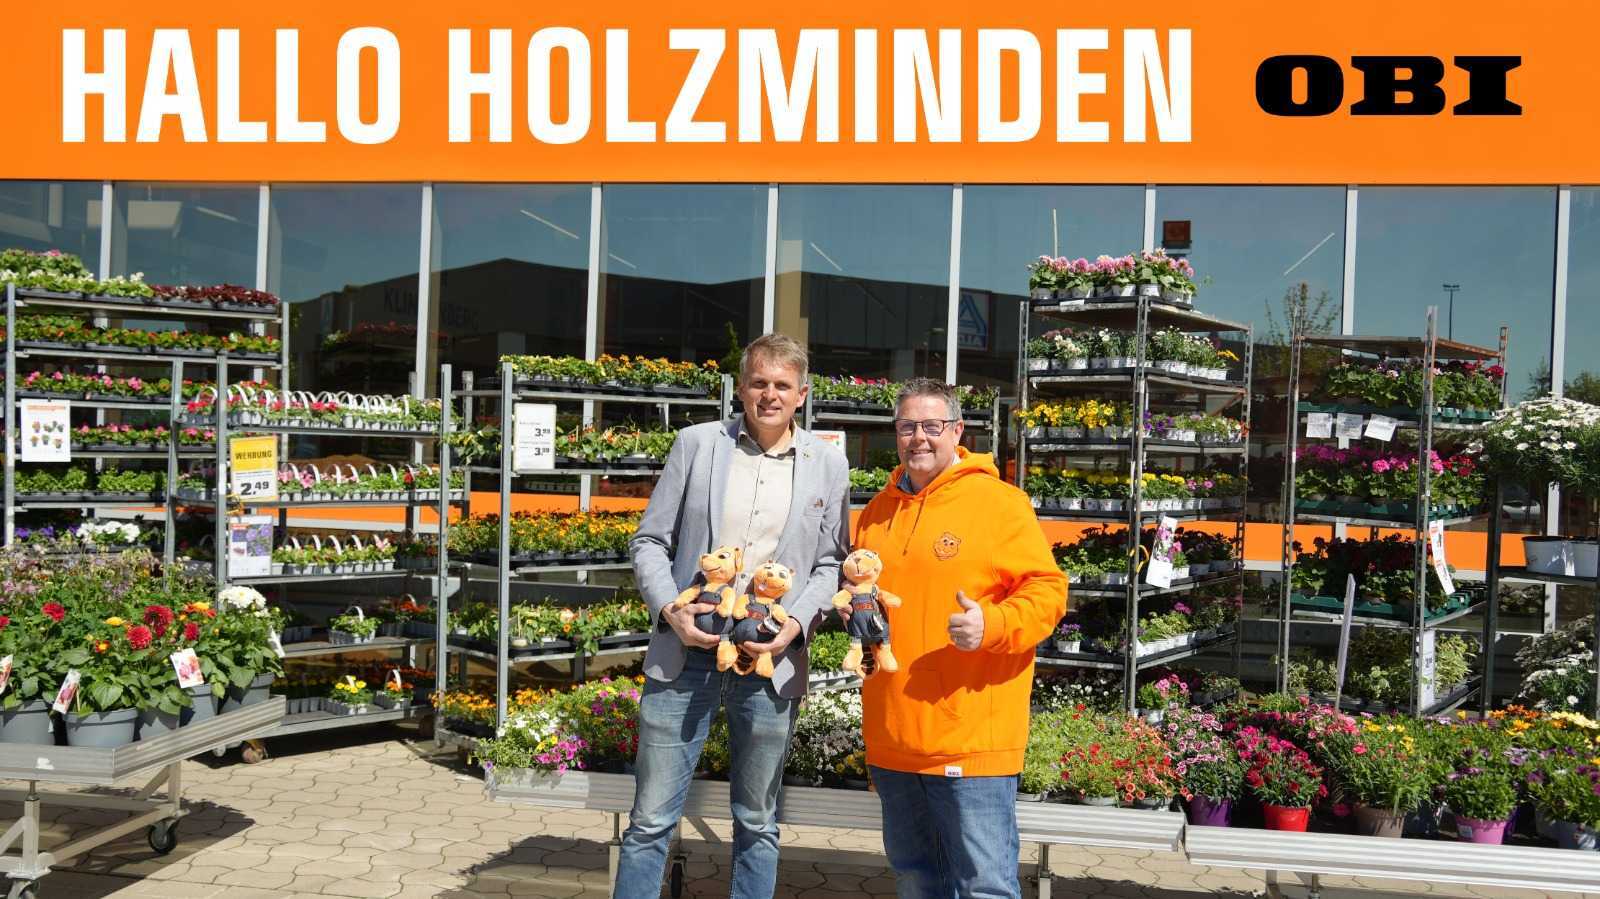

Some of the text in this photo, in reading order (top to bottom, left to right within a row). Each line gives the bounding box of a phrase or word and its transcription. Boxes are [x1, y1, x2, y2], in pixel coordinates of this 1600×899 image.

[62, 27, 1192, 144] HALLO HOLZMINDEN
[1255, 54, 1523, 117] OBI
